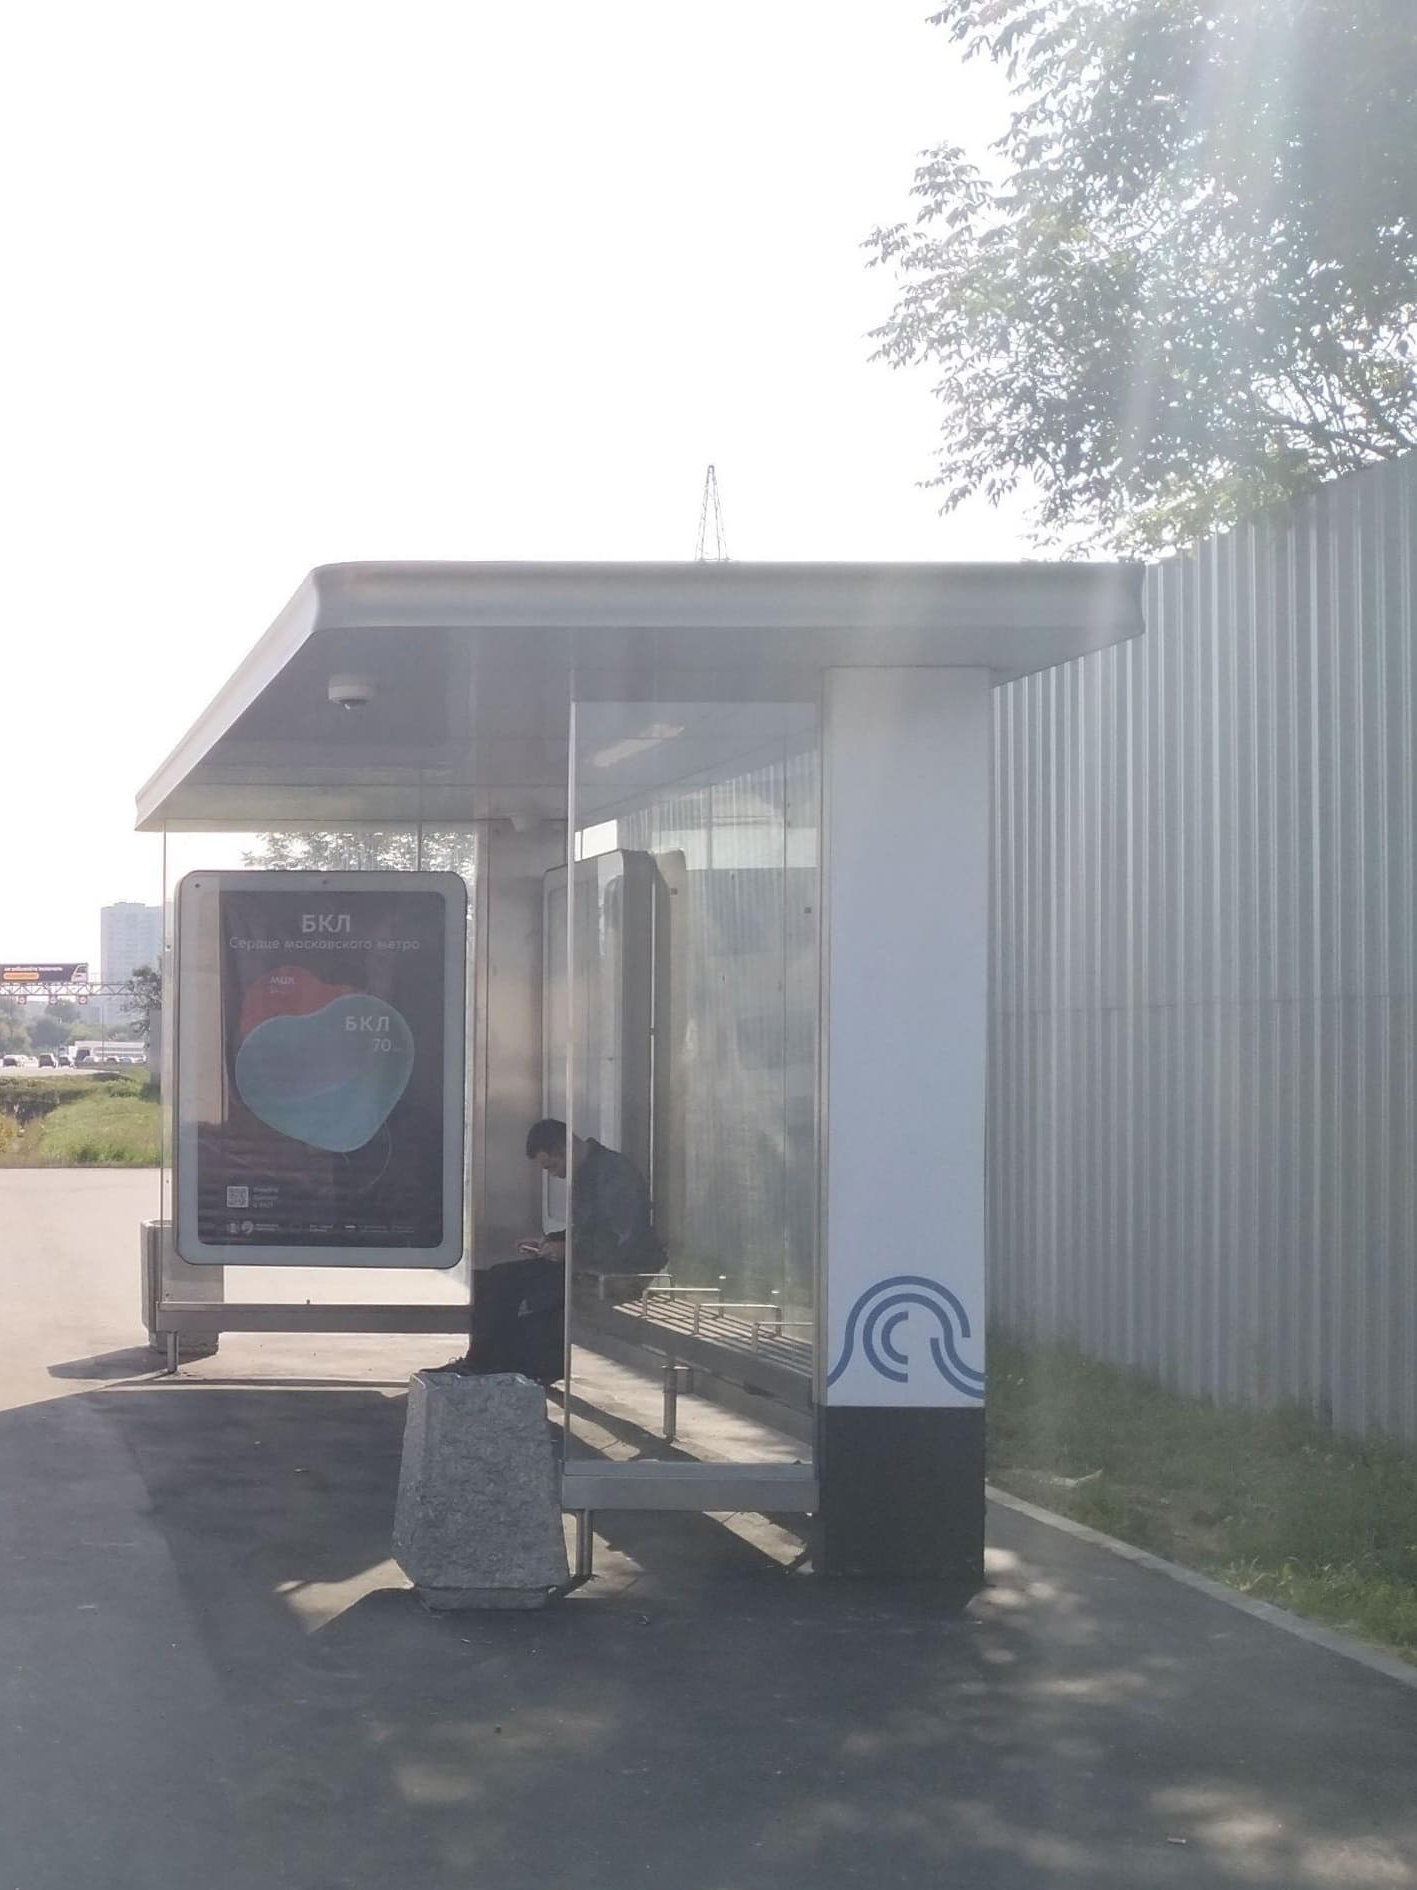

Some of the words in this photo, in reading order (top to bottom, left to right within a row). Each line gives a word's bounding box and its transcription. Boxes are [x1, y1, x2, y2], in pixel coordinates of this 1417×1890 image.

[301, 914, 351, 933] БКЛ
[229, 937, 280, 951] Сердце
[284, 939, 372, 950] московского
[376, 940, 421, 952] метро
[345, 1016, 390, 1032] БКЛ
[373, 1038, 392, 1052] 70
